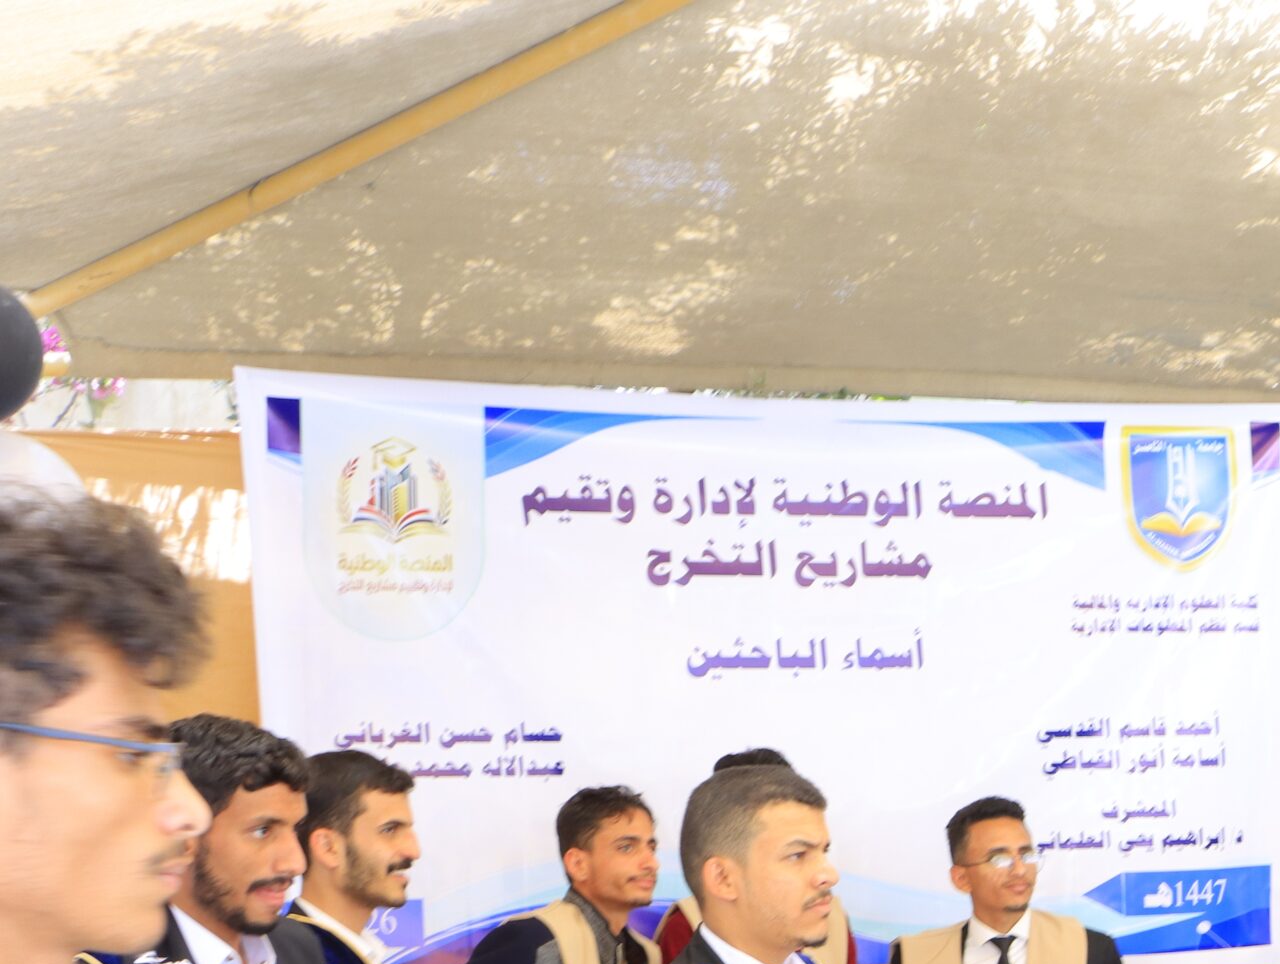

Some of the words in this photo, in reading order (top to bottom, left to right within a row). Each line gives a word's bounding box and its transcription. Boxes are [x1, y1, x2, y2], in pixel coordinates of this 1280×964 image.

[653, 474, 757, 531] لإدارة
[773, 473, 921, 528] الوطنية
[936, 480, 1046, 525] المنصة
[646, 540, 778, 588] التخرج
[795, 541, 933, 586] مشاريع
[1180, 595, 1225, 613] العلوم
[1127, 618, 1193, 636] المعلومات
[1199, 617, 1227, 635] نظم
[1233, 619, 1260, 635] قسم
[687, 637, 829, 680] الباحثين
[841, 628, 924, 673] أسماء
[439, 725, 493, 749] حسن
[504, 721, 563, 750] حسام
[1037, 716, 1111, 748] القدسي
[1120, 716, 1167, 742] قاسم
[1175, 710, 1220, 737] أحمد
[1043, 749, 1120, 781] القباطي
[1128, 743, 1165, 773] أنور
[1172, 742, 1226, 768] أسامة
[1100, 798, 1177, 823] المشرف
[1162, 826, 1225, 855] إبراهيم
